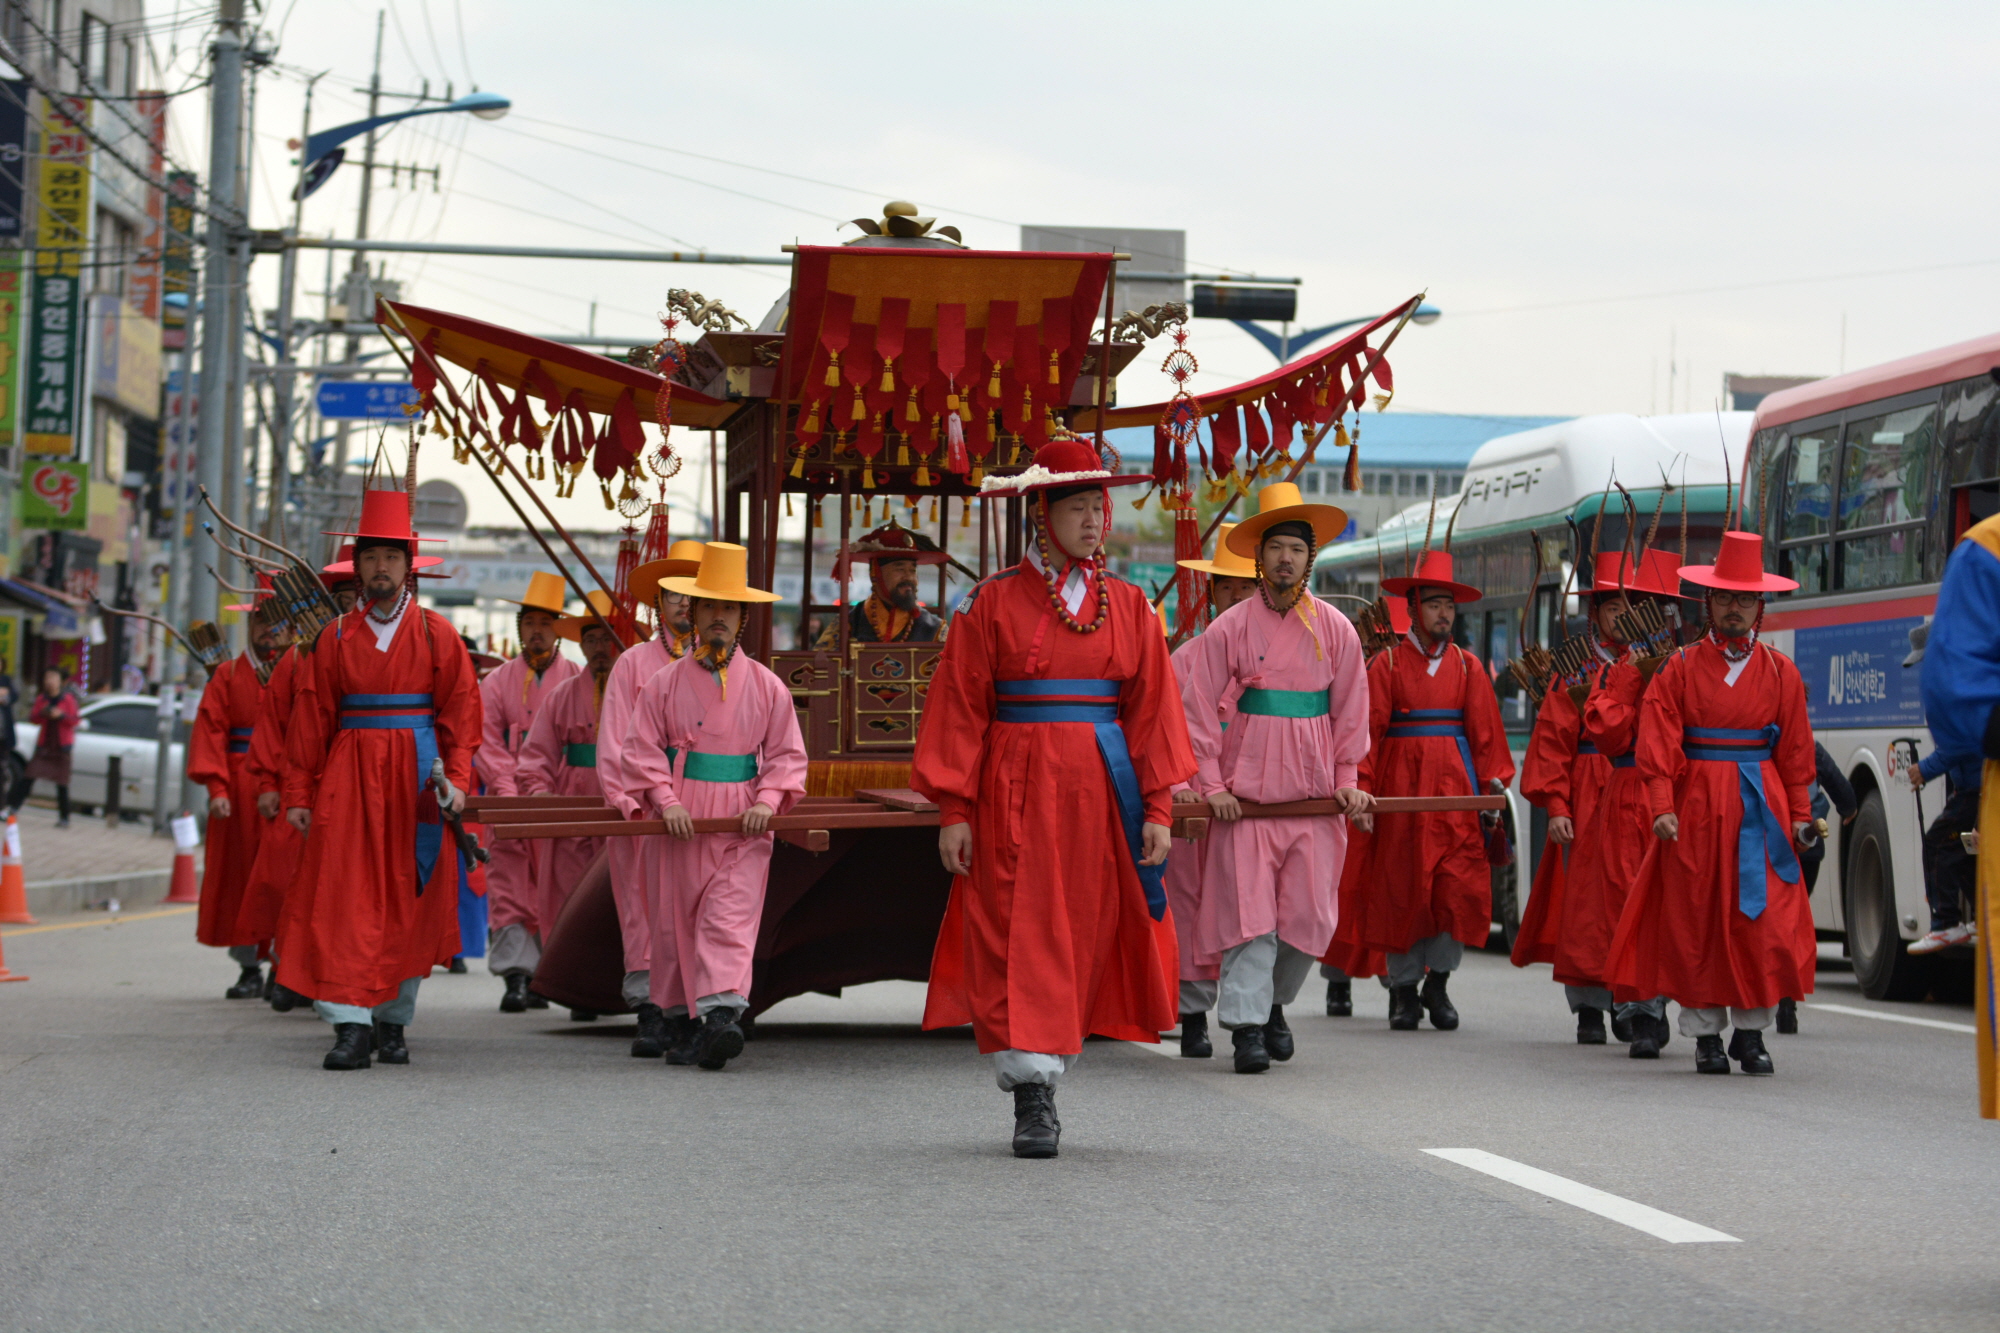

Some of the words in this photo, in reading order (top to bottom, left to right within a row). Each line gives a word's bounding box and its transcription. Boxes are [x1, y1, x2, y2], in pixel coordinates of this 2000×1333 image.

[36, 278, 71, 414] 공인중개사
[33, 466, 79, 516] 약
[1828, 655, 1844, 705] AU
[1846, 668, 1886, 704] 안산대학교
